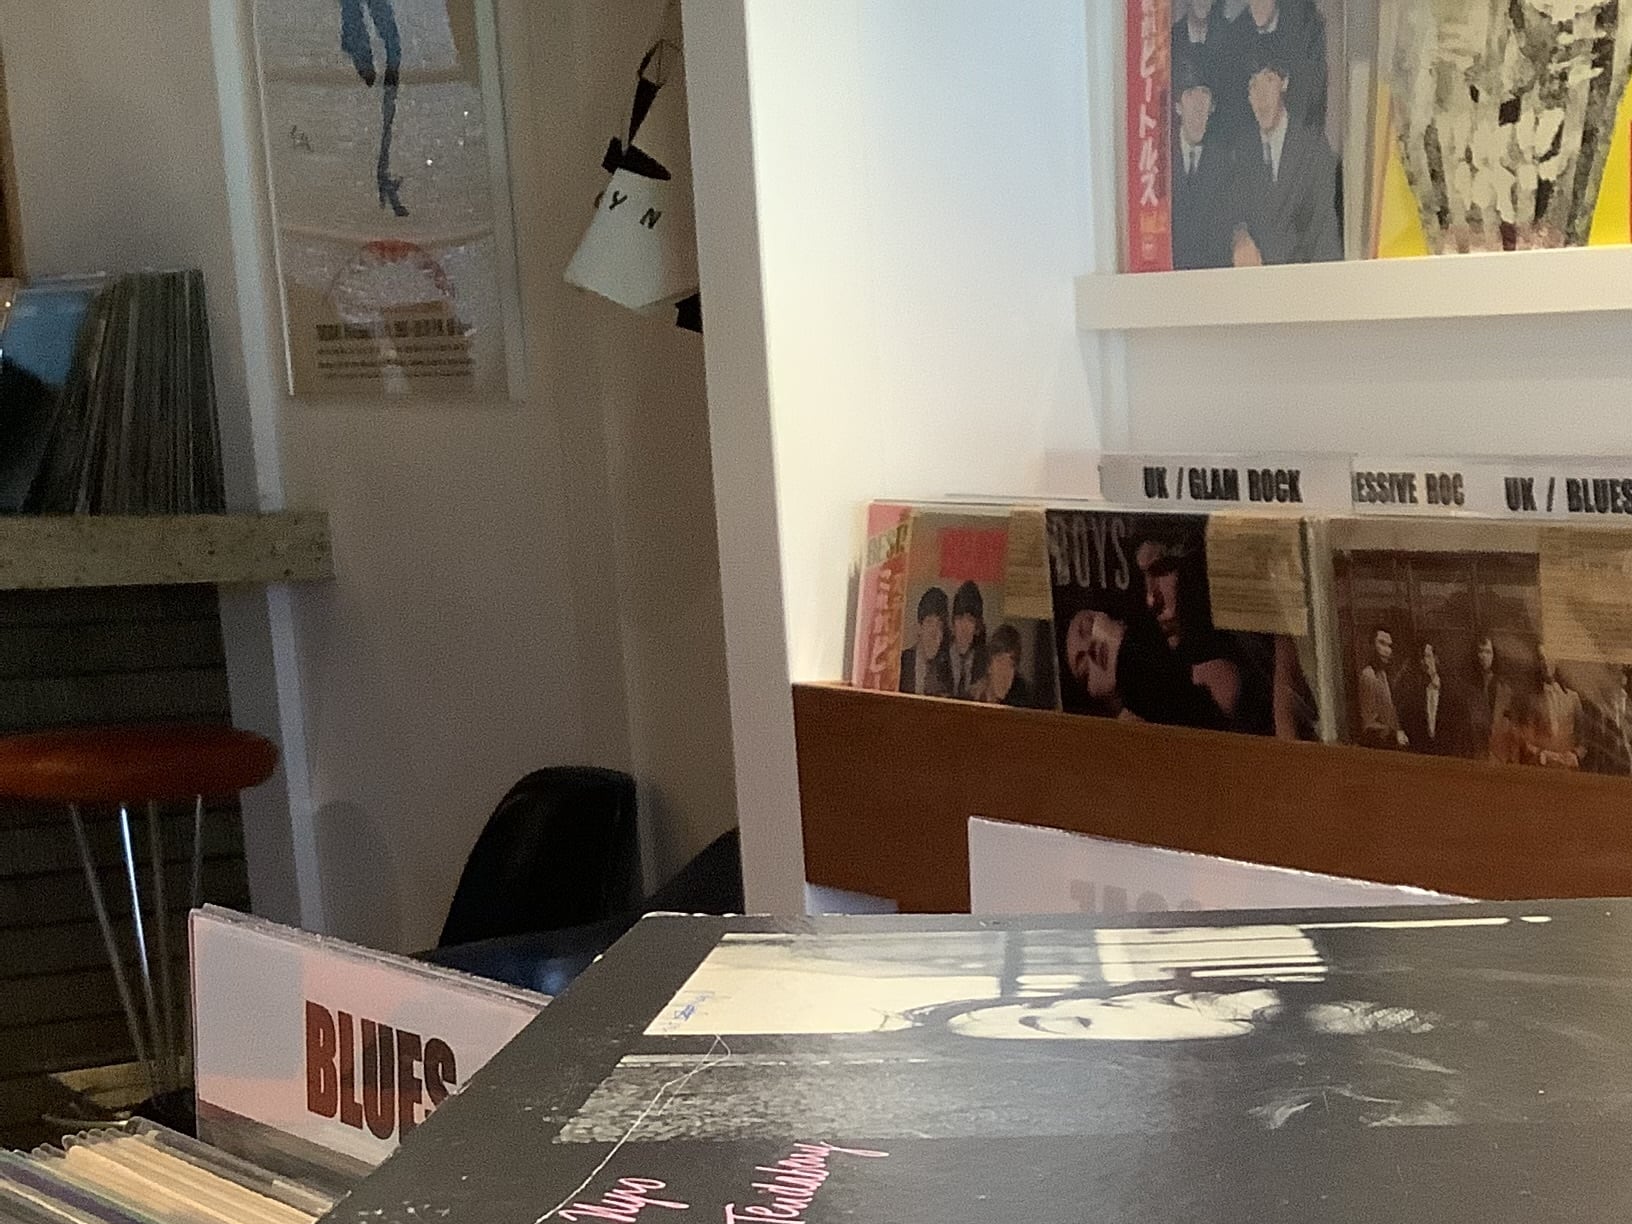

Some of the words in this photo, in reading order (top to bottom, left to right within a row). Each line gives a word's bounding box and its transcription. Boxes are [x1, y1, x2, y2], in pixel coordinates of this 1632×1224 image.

[1143, 466, 1169, 500] UK
[1188, 467, 1241, 502] GLAM
[1248, 468, 1304, 504] ROCK
[1503, 476, 1538, 513] UK
[305, 1000, 457, 1146] BLUES
[557, 1176, 691, 1224] Nyro
